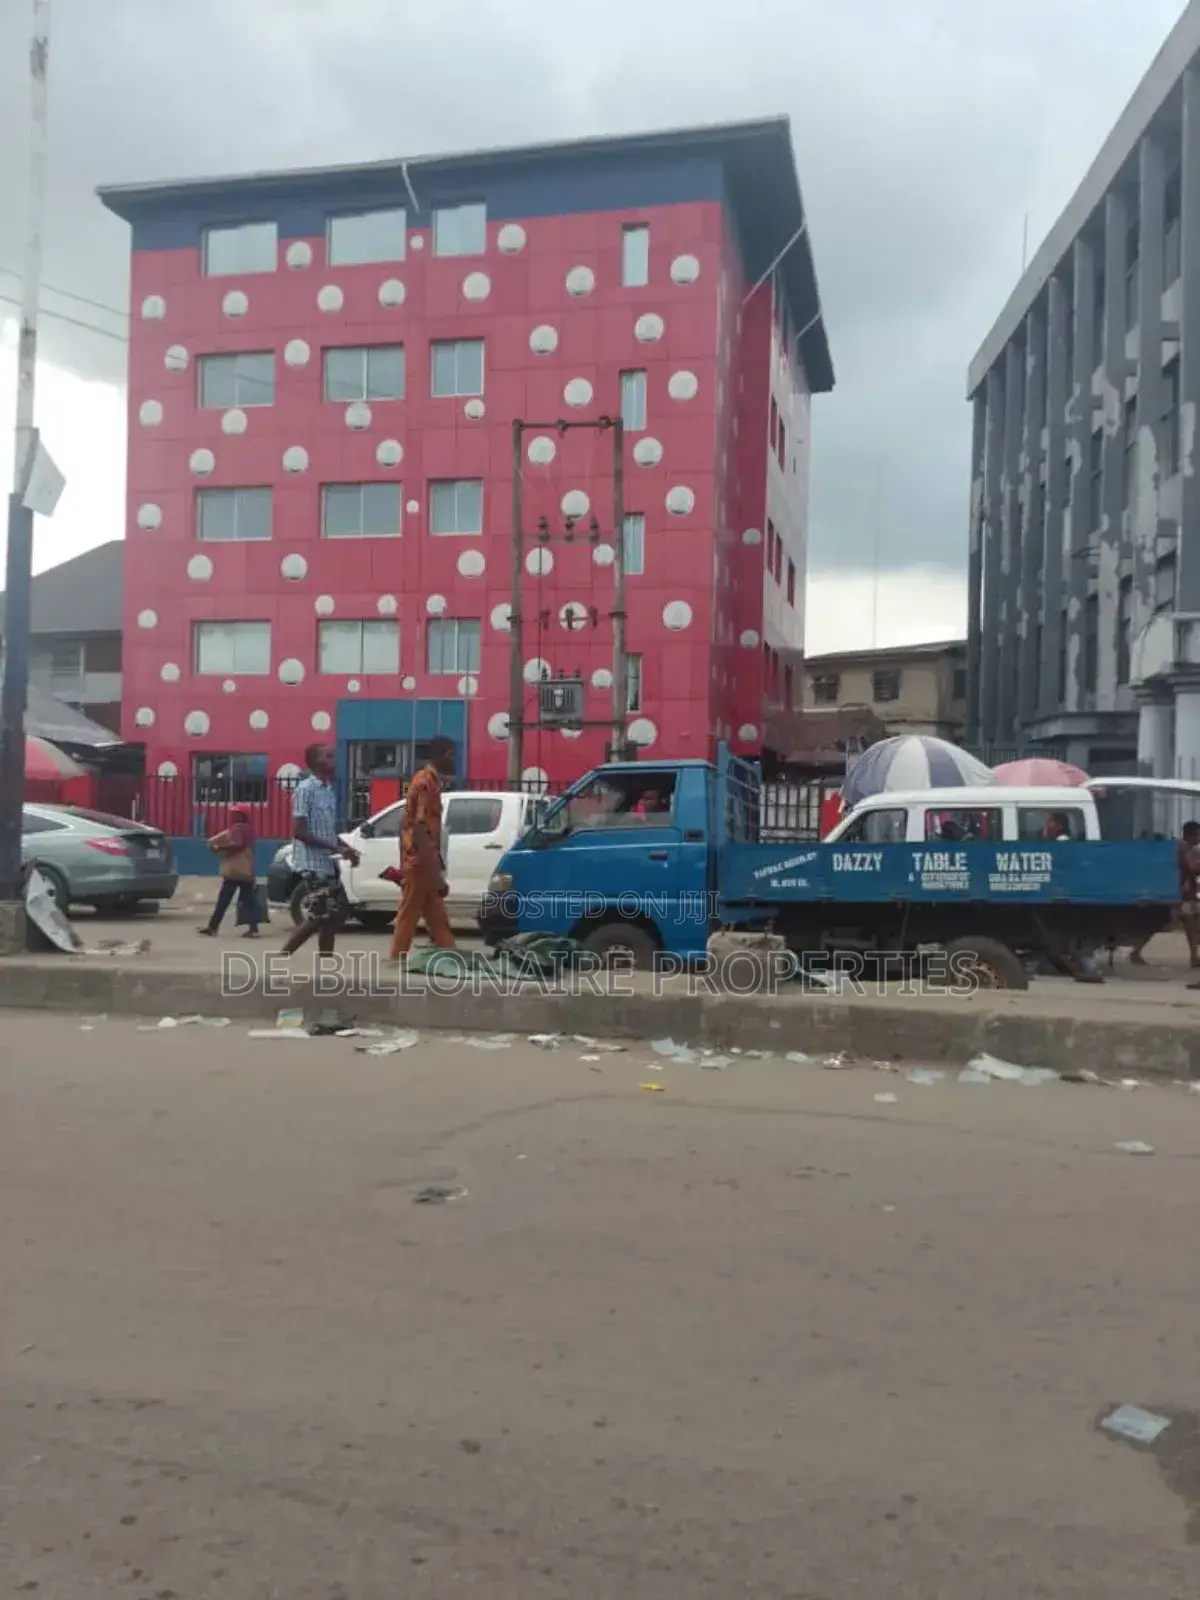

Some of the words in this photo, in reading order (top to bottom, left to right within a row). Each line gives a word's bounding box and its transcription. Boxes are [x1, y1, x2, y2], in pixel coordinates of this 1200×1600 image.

[832, 852, 882, 872] DAZZY
[912, 852, 967, 871] TABLE
[995, 852, 1052, 871] WATER
